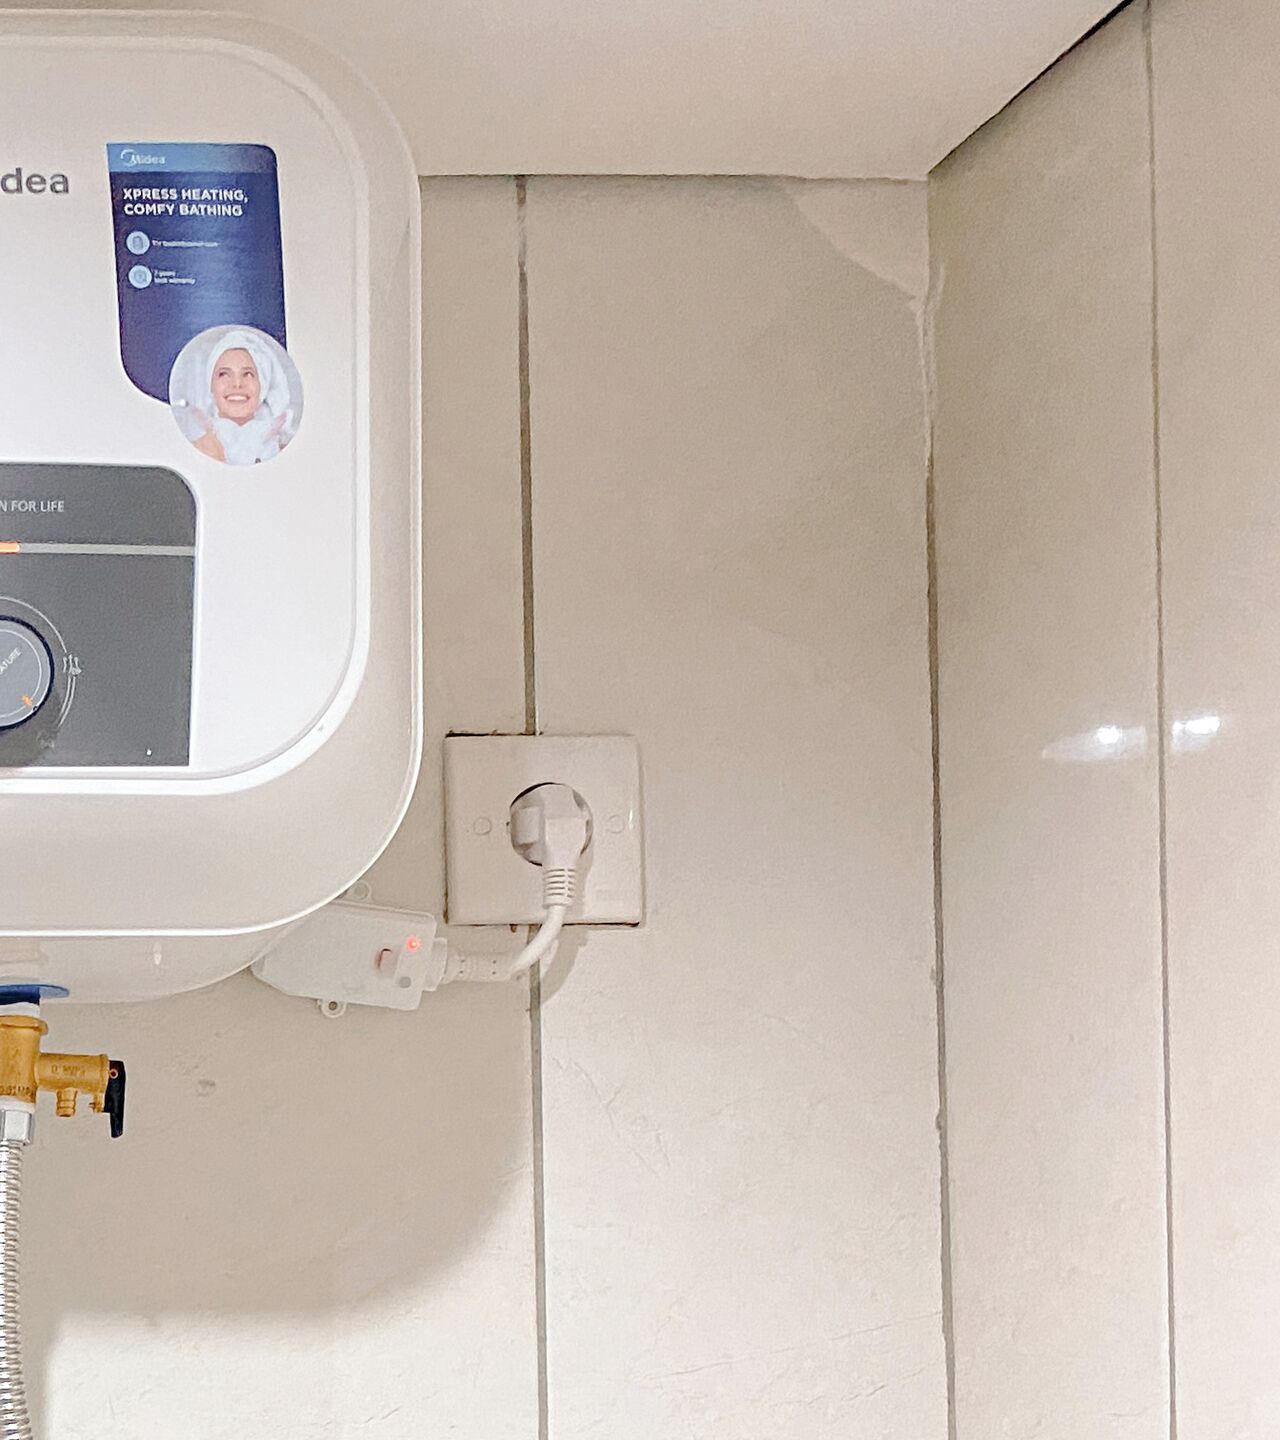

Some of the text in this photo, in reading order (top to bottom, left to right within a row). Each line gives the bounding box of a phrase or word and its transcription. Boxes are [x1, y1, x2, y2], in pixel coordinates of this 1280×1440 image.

[121, 149, 165, 167] Midea
[123, 188, 248, 203] XPRESS HEATING,
[124, 203, 243, 216] COMFY BATHING
[11, 500, 36, 512] FOR
[41, 500, 65, 512] LIFE
